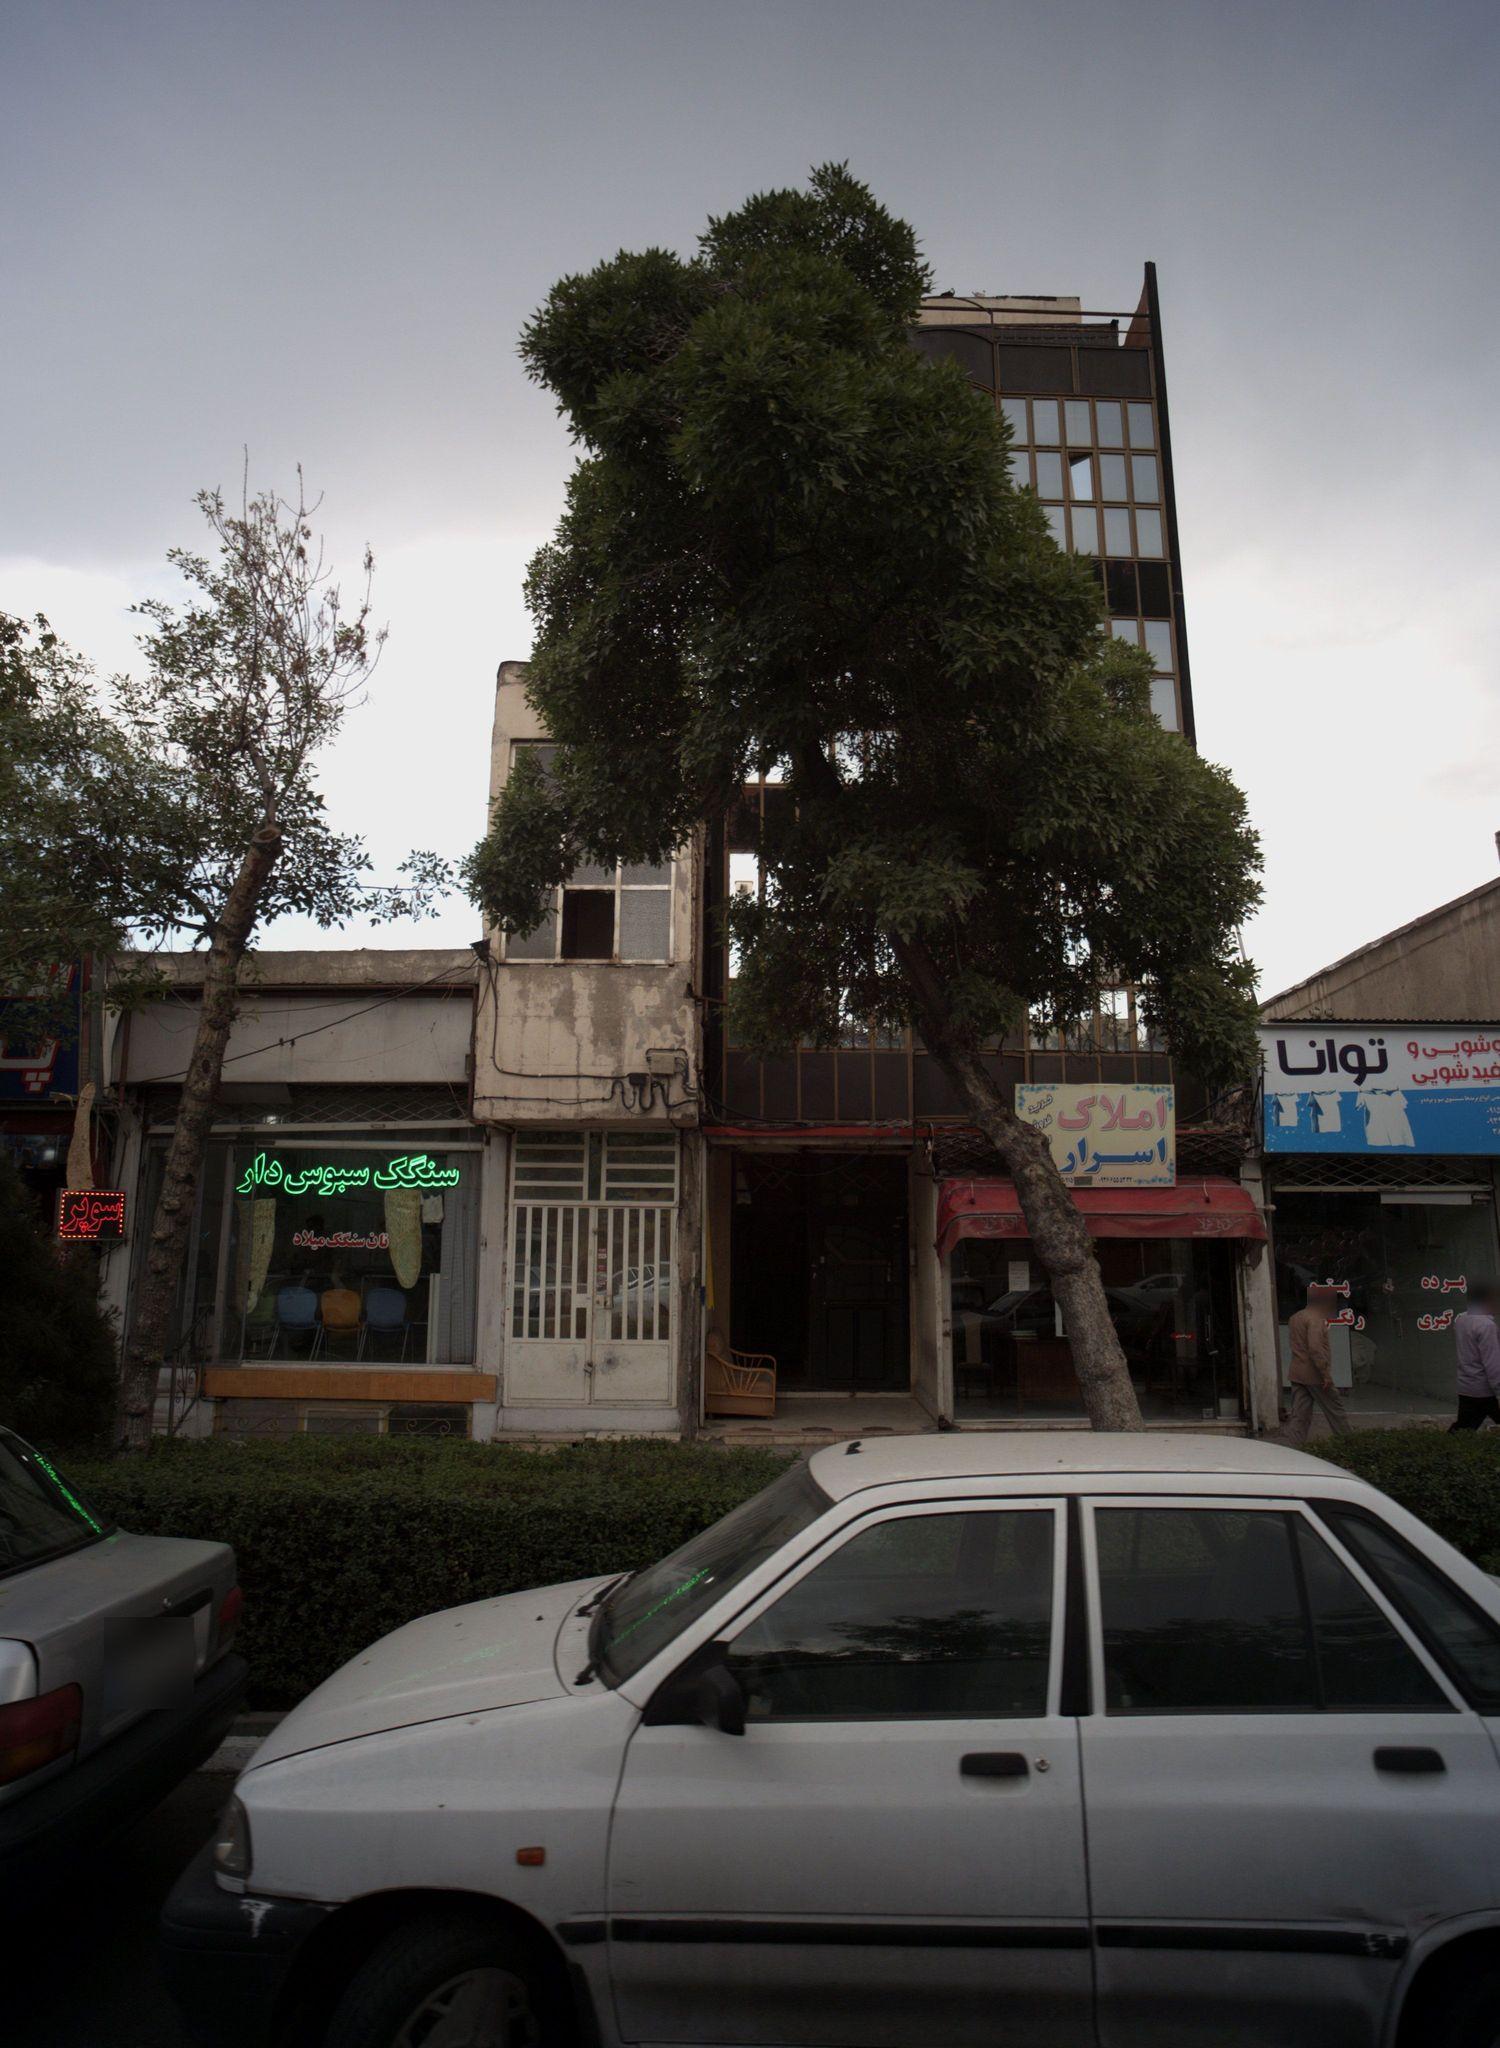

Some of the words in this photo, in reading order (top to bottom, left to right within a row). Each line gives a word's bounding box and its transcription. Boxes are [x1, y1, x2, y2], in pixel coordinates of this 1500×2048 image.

[1276, 1037, 1389, 1087] توانا
[1057, 1094, 1167, 1131] املاک
[235, 1152, 284, 1194] دار
[372, 1154, 460, 1191] سنگک
[1060, 1136, 1167, 1174] اسرار
[283, 1164, 371, 1196] سبوس
[62, 1196, 121, 1234] سوپر
[292, 1229, 326, 1251] میلاد
[325, 1231, 367, 1248] سنگک
[366, 1231, 390, 1250] نان
[1420, 1274, 1468, 1294] پرده
